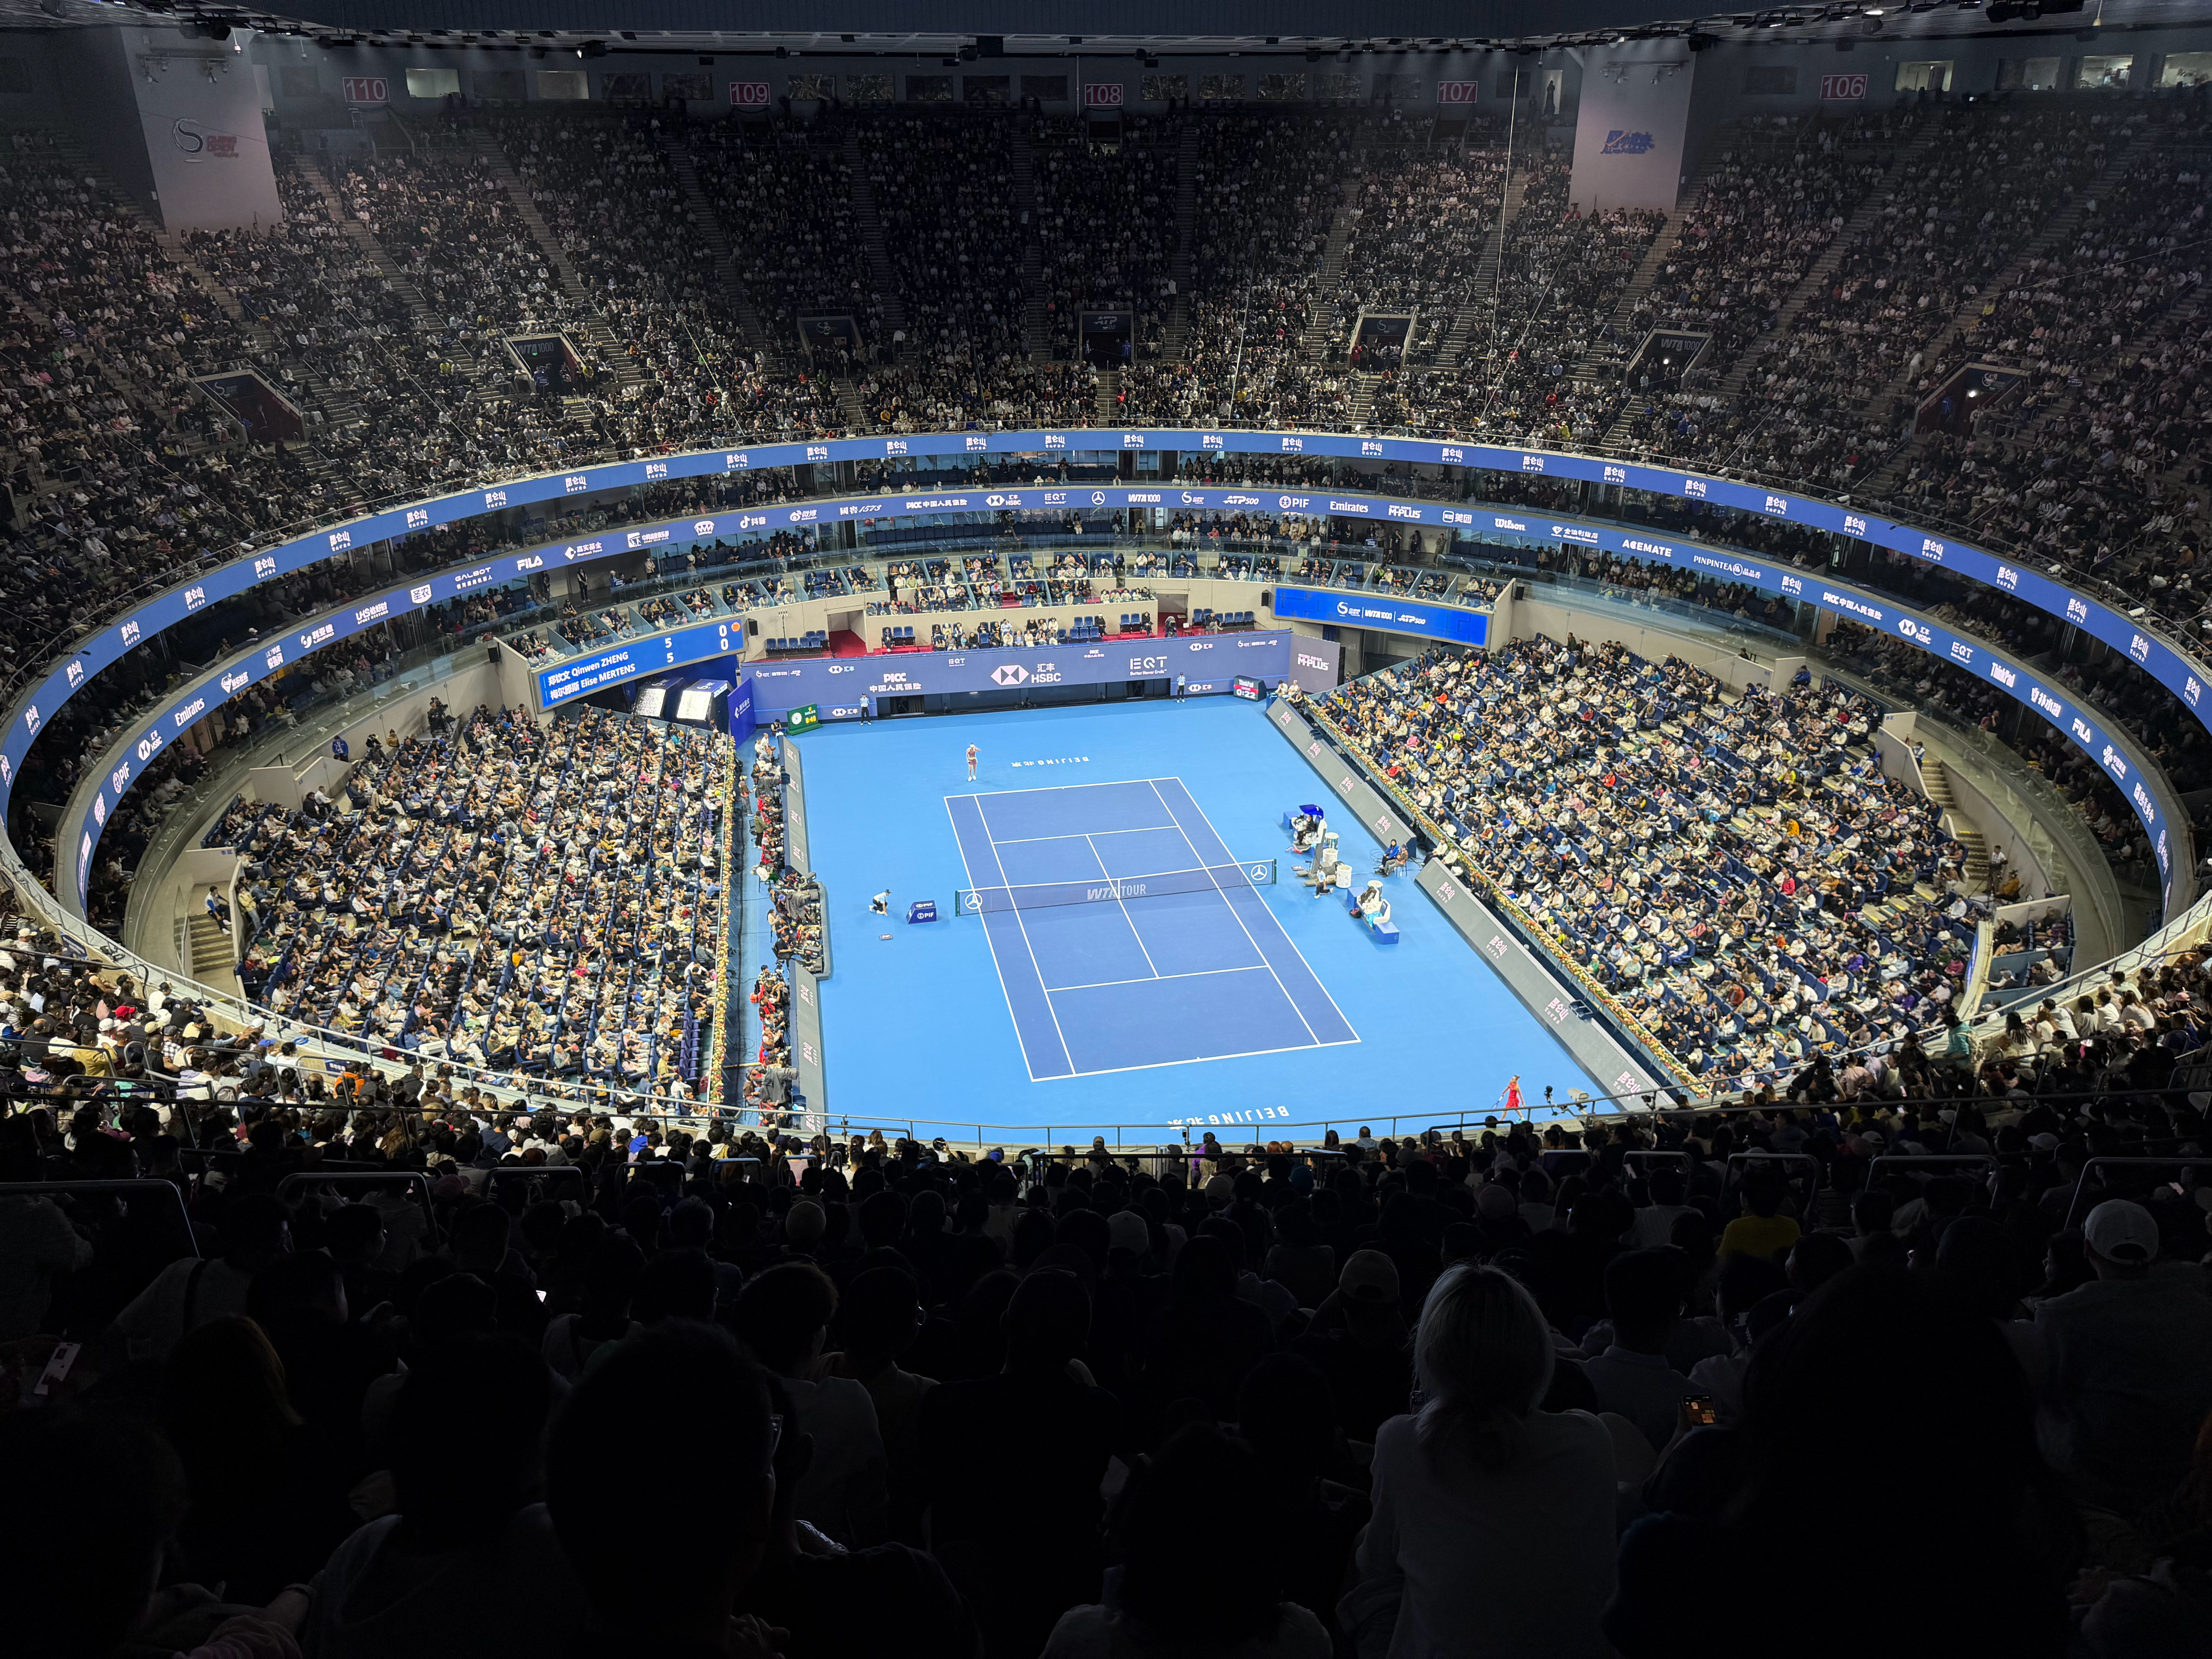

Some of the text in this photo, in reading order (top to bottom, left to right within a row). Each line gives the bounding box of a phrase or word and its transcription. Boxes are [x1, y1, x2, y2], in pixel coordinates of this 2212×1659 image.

[346, 79, 386, 100] 110
[732, 84, 768, 103] 109
[1439, 83, 1475, 101] 107
[1824, 76, 1864, 98] 106
[1087, 86, 1121, 103] 108
[1093, 316, 1117, 325] ATP
[887, 441, 907, 450] 昆仑山
[966, 437, 987, 447] 昆仑山
[1045, 435, 1065, 444] 昆仑山
[1124, 434, 1144, 443] 昆仑山
[1203, 435, 1223, 445] 昆仑山
[1282, 438, 1302, 448] 昆仑山
[807, 446, 828, 456] 昆仑山
[1362, 442, 1382, 452] 昆仑山
[1442, 448, 1463, 459] 昆仑山
[726, 453, 748, 464] 昆仑山
[1523, 456, 1544, 468] 昆仑山
[646, 463, 667, 475] 昆仑山
[1604, 466, 1625, 479] 昆仑山
[565, 476, 587, 487] 昆仑山
[1685, 480, 1706, 493] 昆仑山
[485, 490, 507, 504] 昆仑山
[923, 499, 967, 508] 中国人民保险
[1292, 498, 1310, 508] PIF
[1765, 496, 1787, 511] 昆仑山
[1330, 501, 1368, 513] Emirates
[407, 509, 428, 524] 昆仑山
[751, 517, 766, 526] 抖音
[1455, 513, 1472, 524] 美团
[1495, 518, 1526, 531] Wilson
[1844, 516, 1865, 532] 昆仑山
[329, 530, 351, 547] 昆仑山
[1622, 539, 1672, 557] ACEMATE
[1922, 539, 1943, 556] 昆仑山
[254, 556, 276, 574] 昆仑山
[517, 555, 543, 571] FILA
[1693, 555, 1732, 571] PINPINTEA
[455, 567, 491, 582] GALBOT
[1997, 566, 2017, 586] 昆仑山
[1781, 575, 1802, 591] 昆仑山
[185, 586, 205, 605] 昆仑山
[413, 587, 429, 600] 圣农
[1823, 592, 1882, 620] PICC 中国人民保险
[2067, 598, 2087, 619] 昆仑山
[121, 620, 139, 641] 昆仑山
[1915, 632, 1931, 644] HSBC
[1952, 641, 1973, 659] EQT
[2131, 634, 2148, 658] 昆仑山
[548, 625, 727, 686] 郑钦文 Qinwen ZHENG 5 0
[580, 677, 598, 688] Elise
[599, 663, 635, 682] MERTENS
[667, 652, 674, 663] 5
[721, 638, 728, 651] 0
[1037, 663, 1055, 672] 汇丰
[1130, 656, 1167, 670] EQT
[1298, 657, 1328, 671] M-PLUS
[883, 673, 907, 683] PICC
[1031, 673, 1061, 683] HSBC
[1990, 662, 2015, 688] ThinkPad
[869, 682, 922, 692] 中国人民保险
[1237, 689, 1255, 699] 0:22
[175, 698, 205, 727] Emirates
[2072, 718, 2090, 743] FILA
[151, 736, 162, 751] HSBC
[1037, 756, 1089, 766] BEIJING
[118, 761, 129, 784] PIF
[1121, 884, 1146, 896] TOUR
[1439, 881, 1455, 900] 昆仑山
[1489, 935, 1507, 957] 昆仑山
[1547, 998, 1569, 1021] 昆仑山
[1208, 1106, 1290, 1125] BEIJING
